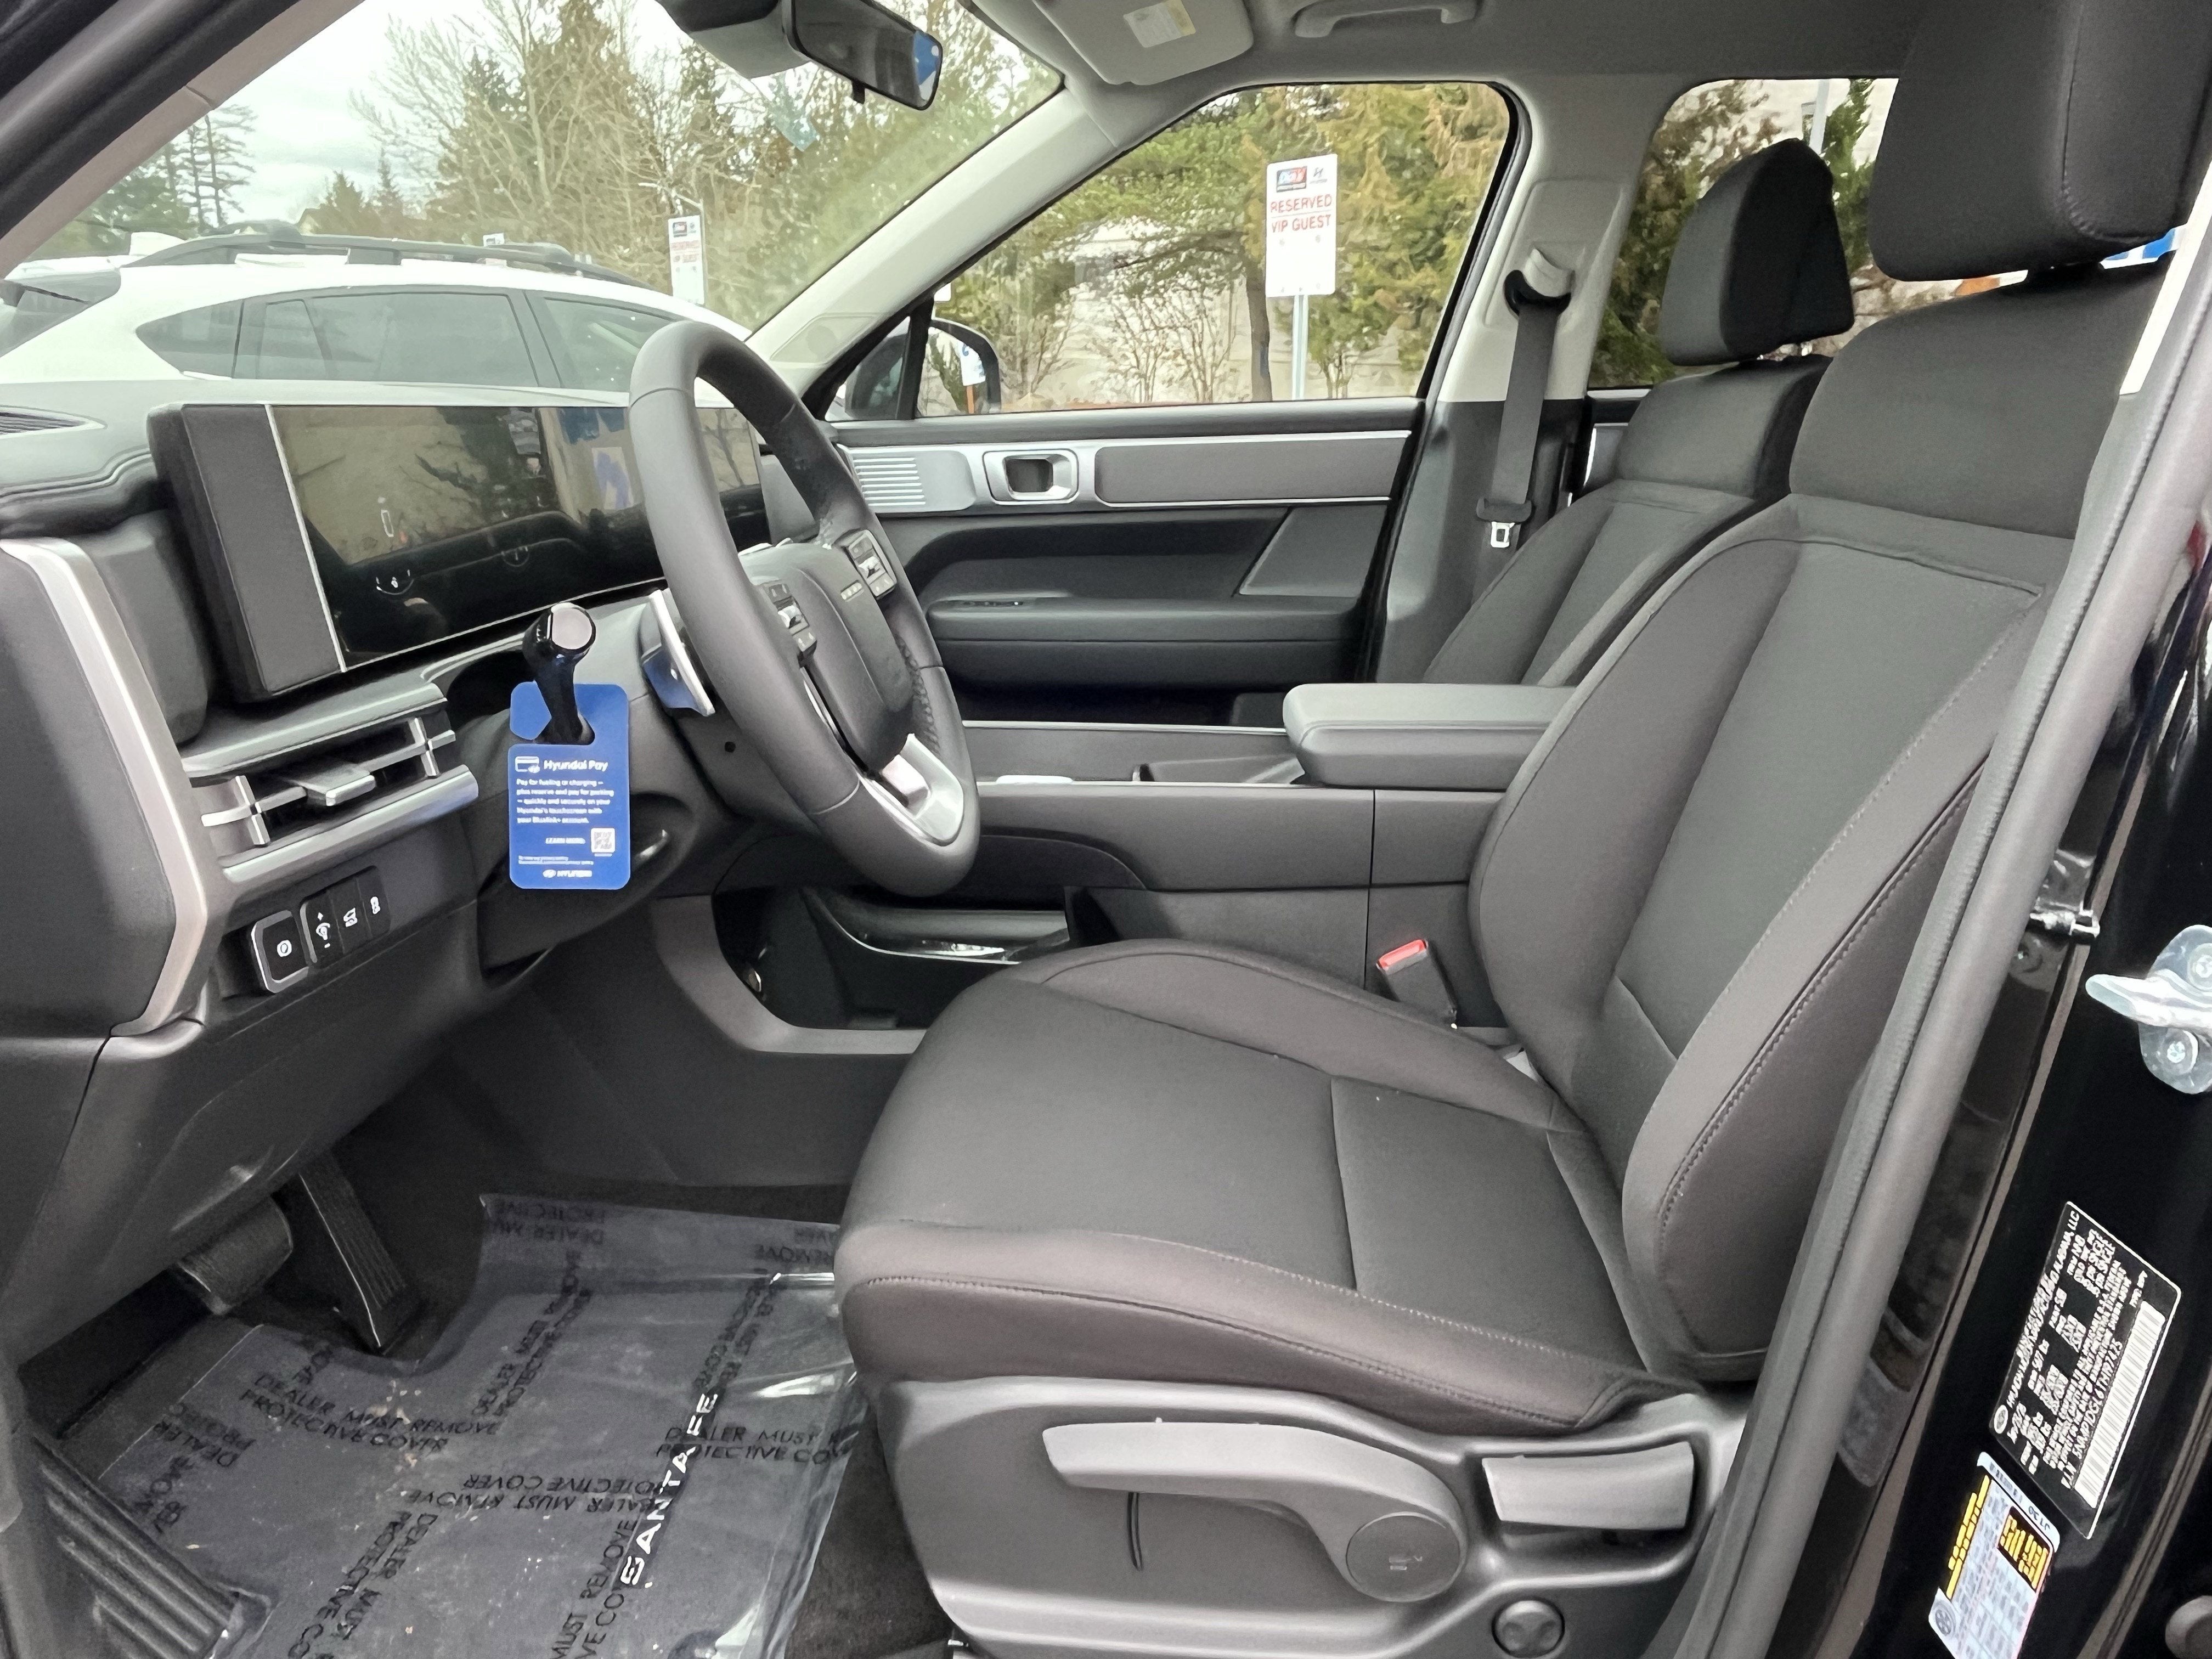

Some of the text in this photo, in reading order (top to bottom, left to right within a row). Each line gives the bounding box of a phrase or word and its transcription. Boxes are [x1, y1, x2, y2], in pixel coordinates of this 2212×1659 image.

[1270, 194, 1332, 213] RESERVED
[1271, 214, 1331, 233] VIP GUEST
[544, 760, 608, 771] Hyundai Pay
[254, 1371, 336, 1416] DEALER
[345, 1408, 405, 1430] MUST
[687, 1393, 719, 1436] FE
[664, 1426, 747, 1442] DLER
[757, 1429, 818, 1446] MUST
[656, 1442, 787, 1462] PTECTIVE
[462, 1474, 656, 1496] OTECTIVE COVER
[514, 1494, 577, 1513] MUST
